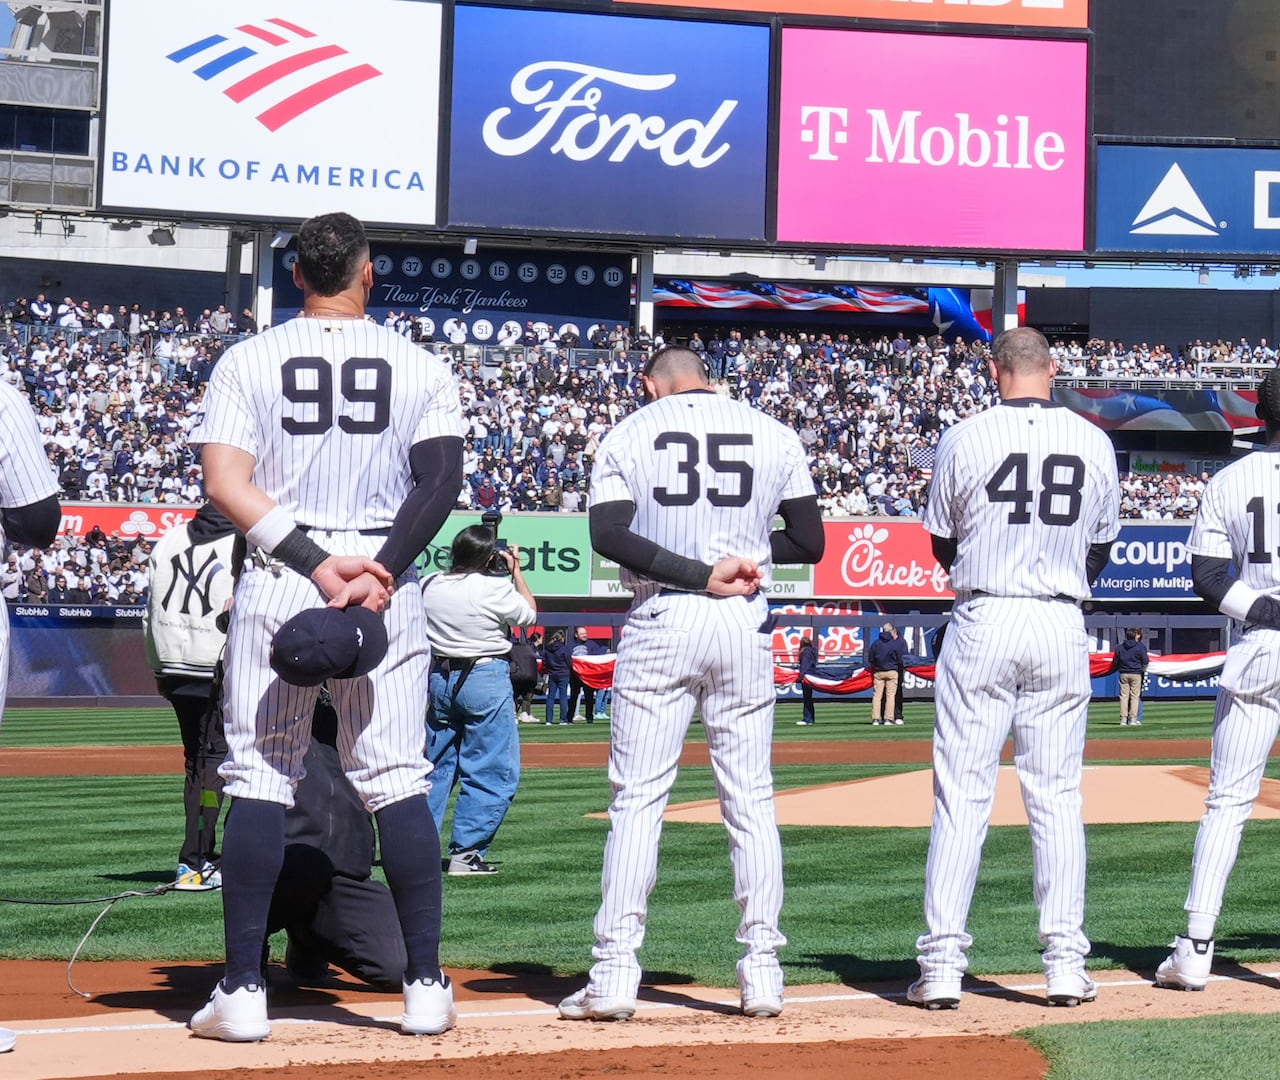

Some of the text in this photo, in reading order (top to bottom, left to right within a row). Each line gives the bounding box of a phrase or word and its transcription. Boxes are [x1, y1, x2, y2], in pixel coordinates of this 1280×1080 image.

[482, 60, 738, 168] Ford
[801, 107, 1065, 171] T Mobile
[111, 150, 425, 191] BANK OF AMERICA
[379, 260, 386, 270] 7
[405, 261, 419, 272] 37
[438, 263, 445, 273] 8
[467, 264, 474, 275] 8
[494, 266, 505, 277] 16
[522, 267, 534, 278] 15
[550, 268, 563, 279] 32
[581, 270, 588, 281] 9
[607, 271, 619, 282] 10
[381, 284, 528, 314] New York Yankees
[477, 324, 488, 334] 51
[281, 356, 392, 436] 99
[653, 431, 753, 507] 35
[986, 453, 1086, 526] 48
[508, 539, 580, 572] ats
[841, 539, 949, 593] Chick-f
[161, 544, 224, 618] NY
[1101, 576, 1150, 591] Margins
[1153, 576, 1193, 591] Multip
[16, 607, 49, 616] StubHub
[59, 607, 92, 617] StubHub
